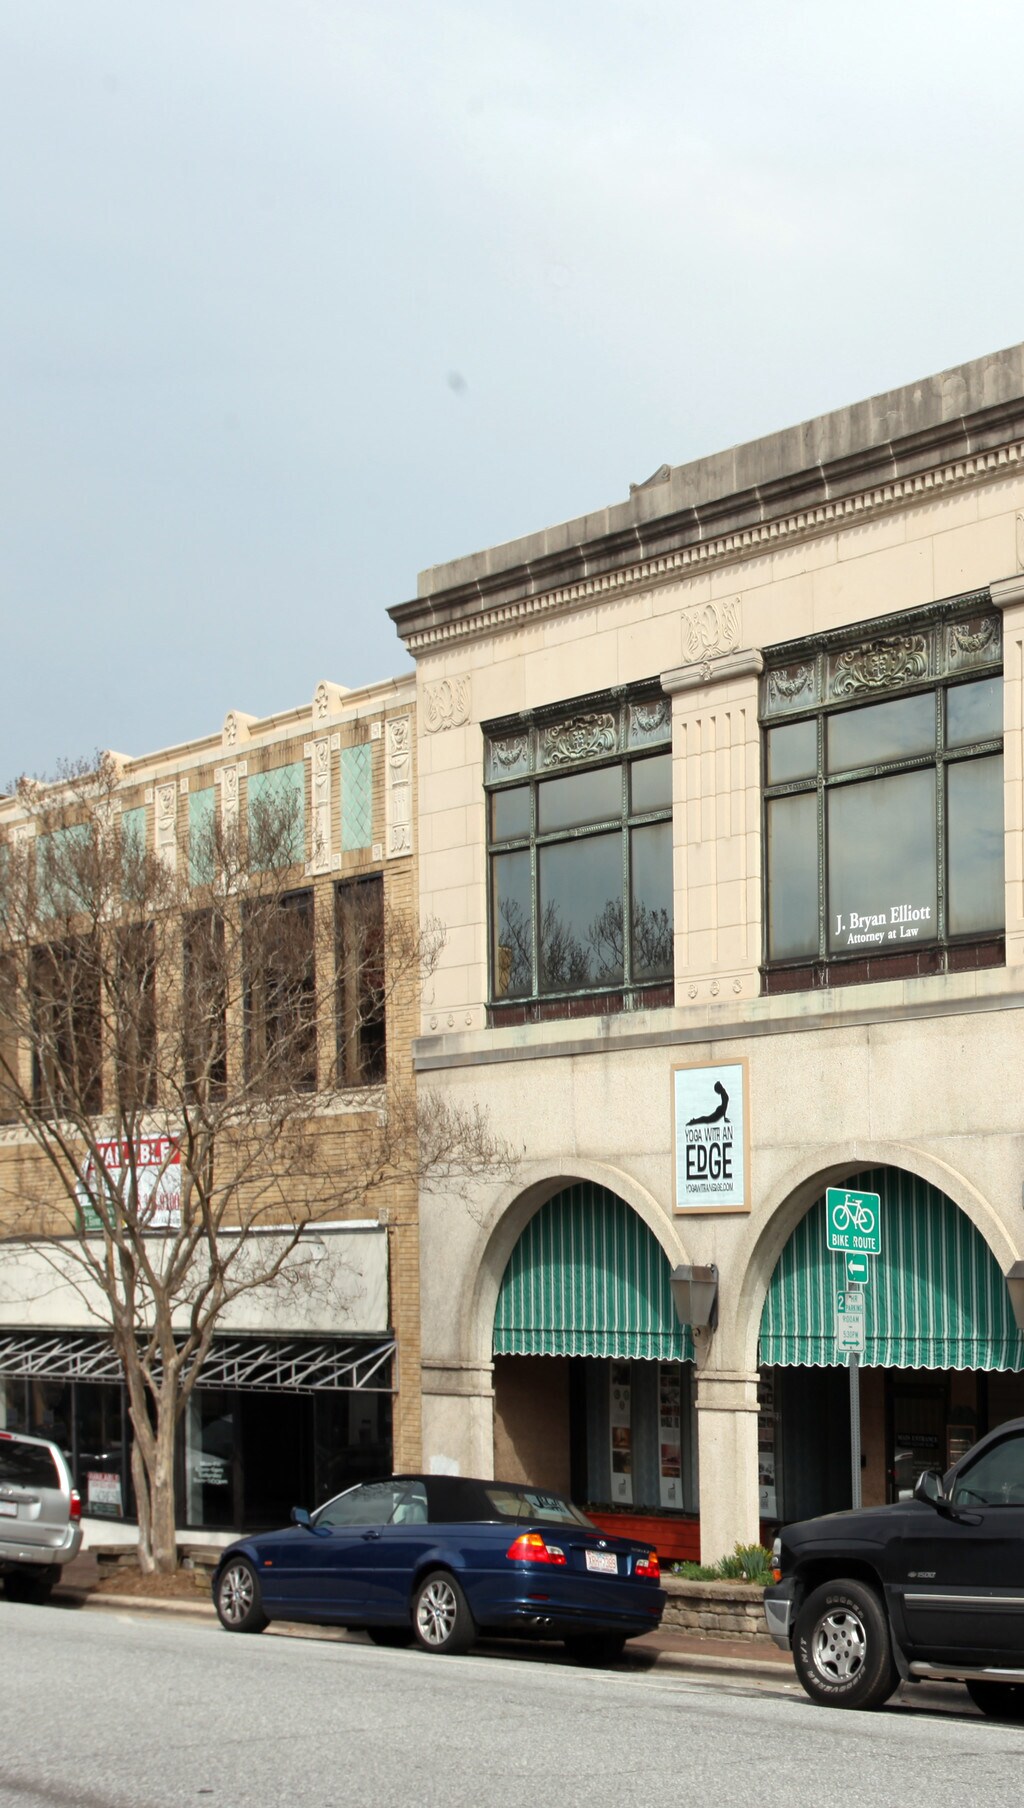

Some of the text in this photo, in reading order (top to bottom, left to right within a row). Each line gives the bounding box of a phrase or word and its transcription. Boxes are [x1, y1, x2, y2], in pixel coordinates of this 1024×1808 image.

[835, 904, 931, 935] J. Bryan Elliott
[847, 925, 919, 944] Attorney at Law
[685, 1126, 734, 1143] YOGA WITH AN
[686, 1142, 733, 1180] EDGE
[832, 1233, 876, 1250] BIKE ROUTE
[838, 1295, 846, 1310] 2
